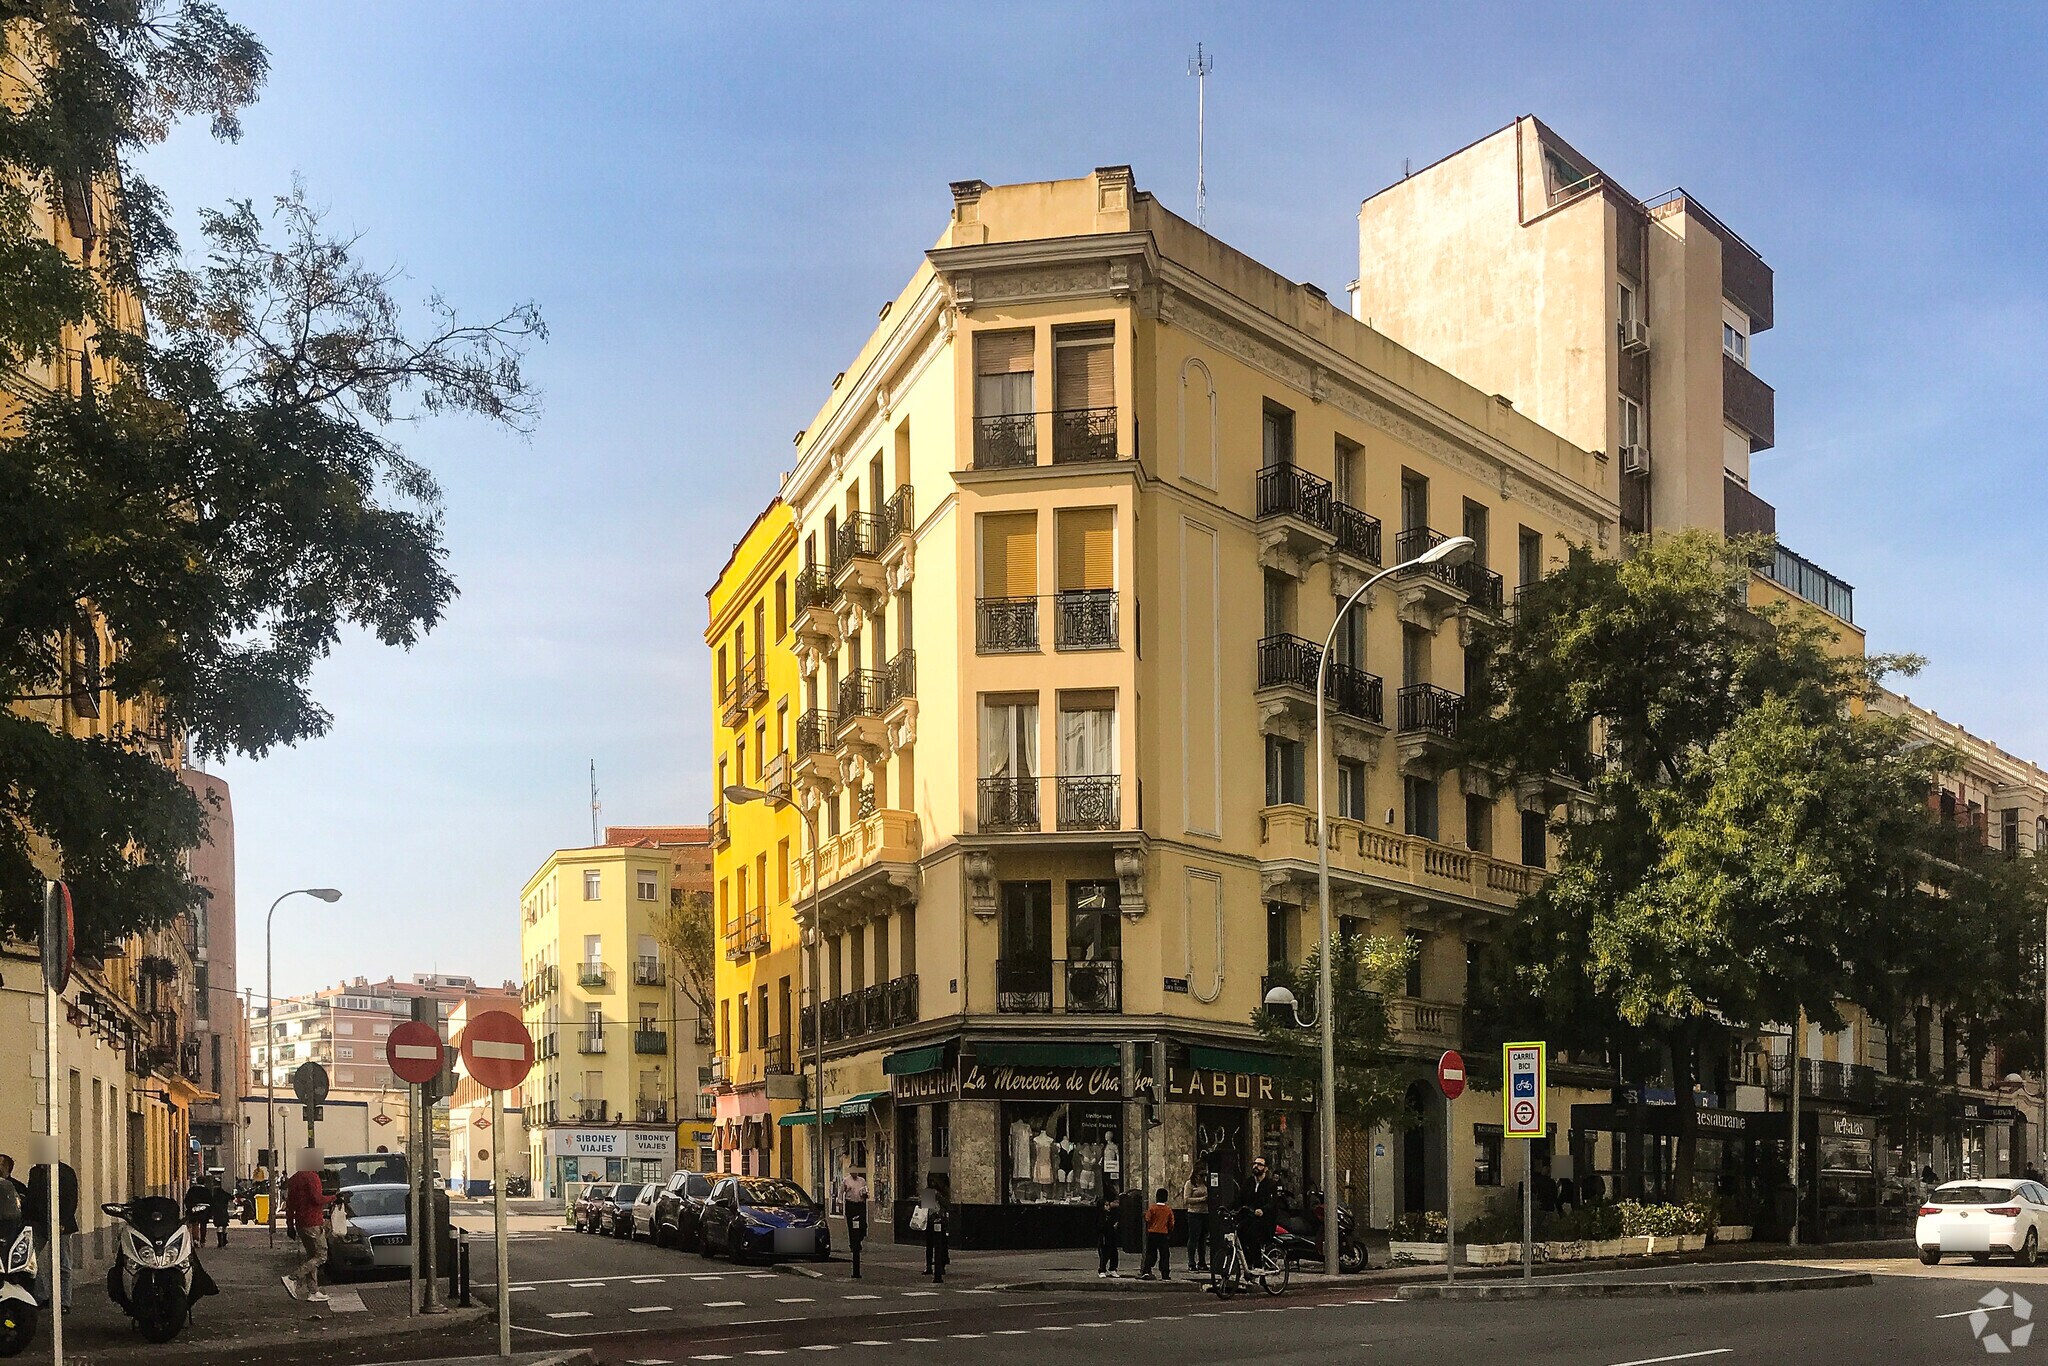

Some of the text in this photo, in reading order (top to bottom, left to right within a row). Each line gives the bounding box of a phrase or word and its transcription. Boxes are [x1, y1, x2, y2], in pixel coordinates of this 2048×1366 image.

[1513, 1053, 1535, 1061] CARRIL
[1518, 1062, 1531, 1070] BICI
[963, 1065, 987, 1090] La
[993, 1067, 1061, 1091] Mercería
[1065, 1069, 1084, 1091] de
[576, 1134, 617, 1143] SIBONEY
[634, 1133, 670, 1142] SIBONEY
[580, 1144, 614, 1153] VIAJES
[638, 1142, 667, 1150] VIAJES
